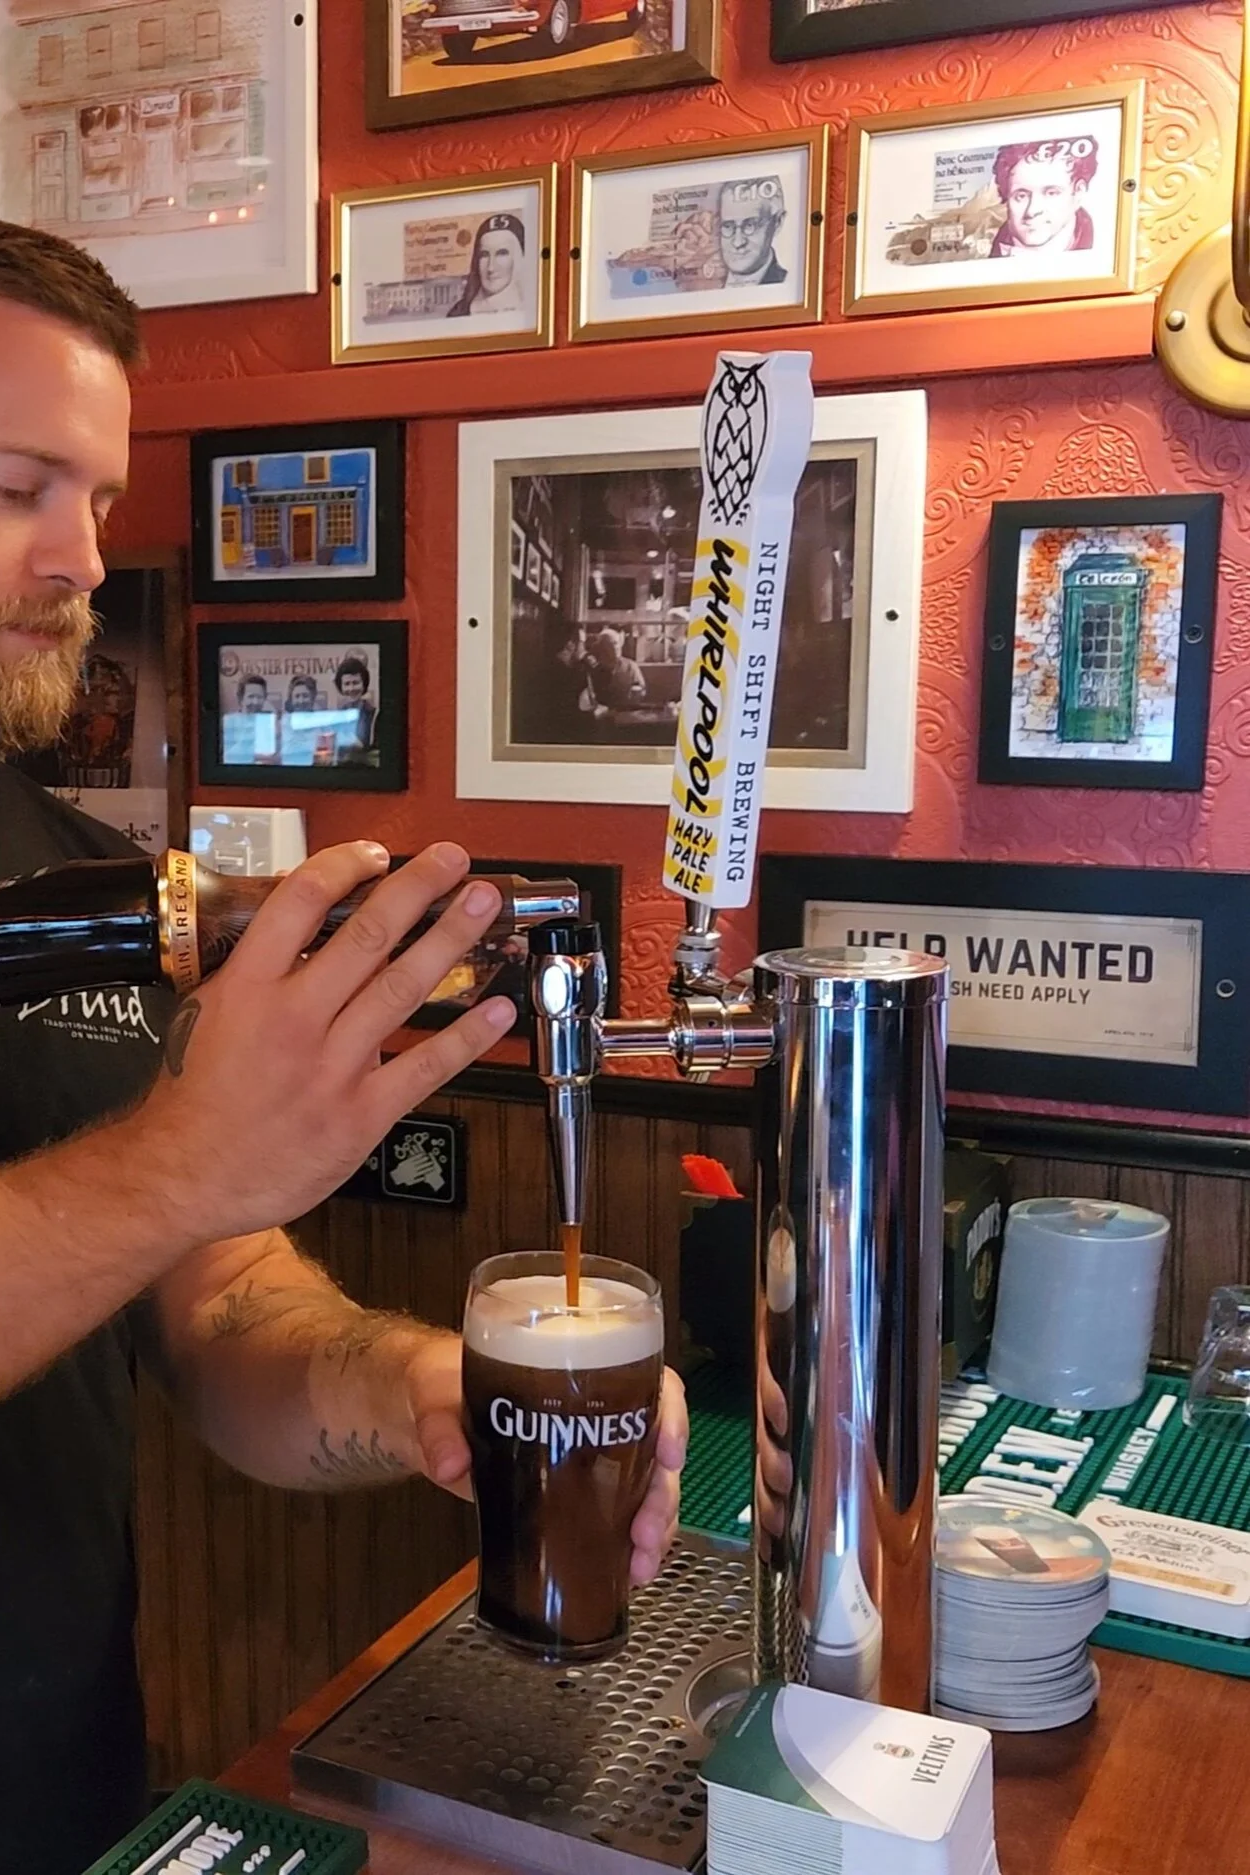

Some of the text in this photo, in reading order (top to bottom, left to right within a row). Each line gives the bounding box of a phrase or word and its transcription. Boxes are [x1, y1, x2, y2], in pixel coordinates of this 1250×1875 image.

[1038, 139, 1093, 163] £20
[734, 181, 778, 202] £10
[685, 538, 735, 814] WHIRLPOOL
[727, 542, 779, 883] NIGHT SHIFT BREWING
[674, 817, 713, 848] HAZY
[672, 841, 710, 873] PALE
[176, 858, 189, 937] IRELAND
[673, 868, 704, 895] ALE
[966, 936, 1154, 984] WANTED
[979, 983, 1024, 1000] NEED
[1031, 986, 1091, 1006] APPLY
[490, 1397, 647, 1449] GUINNESS
[1102, 1426, 1159, 1491] WHISKEY
[910, 1734, 956, 1785] VELTINS
